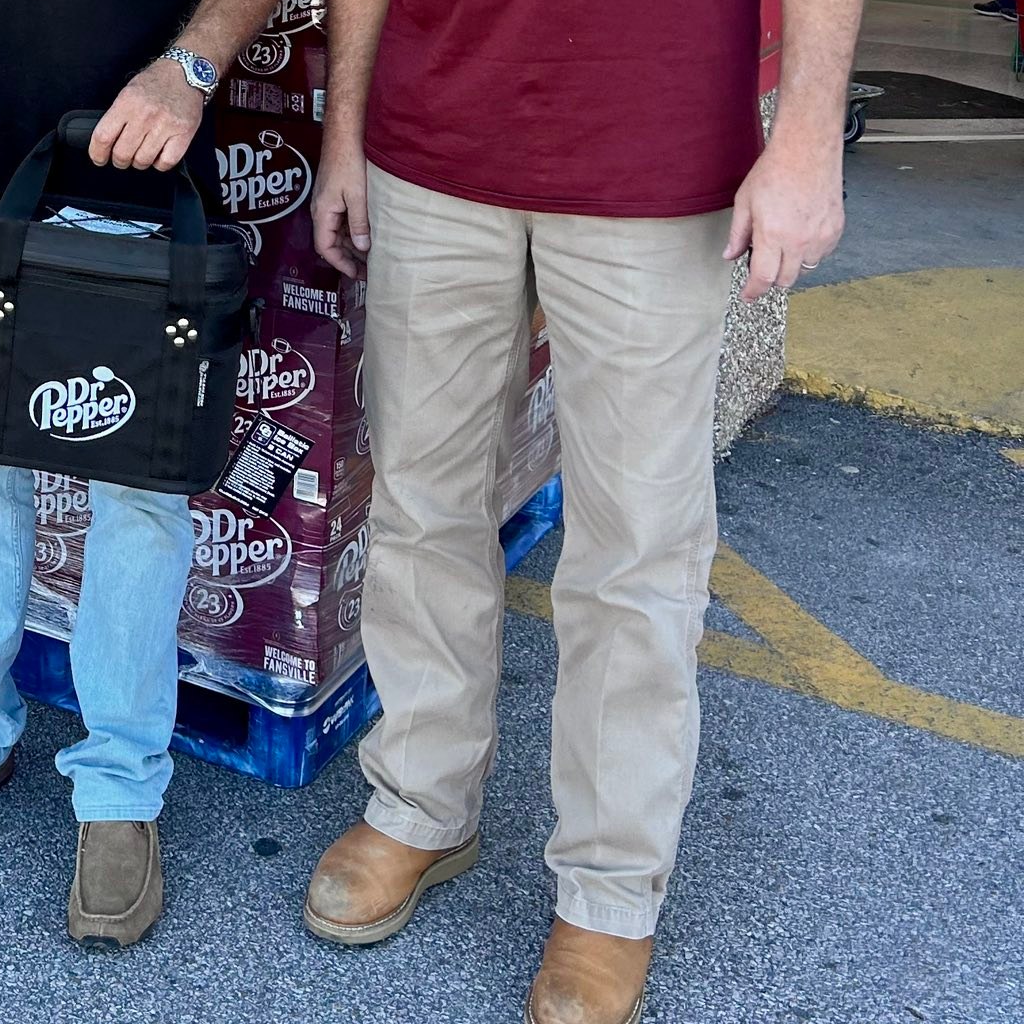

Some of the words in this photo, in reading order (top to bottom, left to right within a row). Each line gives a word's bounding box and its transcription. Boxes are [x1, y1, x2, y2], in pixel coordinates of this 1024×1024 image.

[289, 10, 313, 21] Est.188
[252, 43, 271, 64] 23
[228, 143, 272, 180] Dr
[258, 195, 290, 209] Est.1885
[283, 282, 324, 300] WELCOME
[325, 291, 337, 304] TO
[282, 294, 337, 318] FANSVILLE
[340, 320, 352, 340] 24
[248, 348, 283, 378] Dr
[67, 377, 105, 407] Dr
[270, 389, 296, 399] Est.1885
[29, 380, 128, 434] Pepper
[275, 447, 294, 461] CAN
[212, 509, 254, 543] Dr
[330, 516, 342, 536] 24
[197, 589, 220, 615] 23
[348, 597, 361, 618] 23
[264, 645, 304, 670] WELCOME
[304, 659, 316, 672] TO
[263, 657, 316, 685] FANSVILLE
